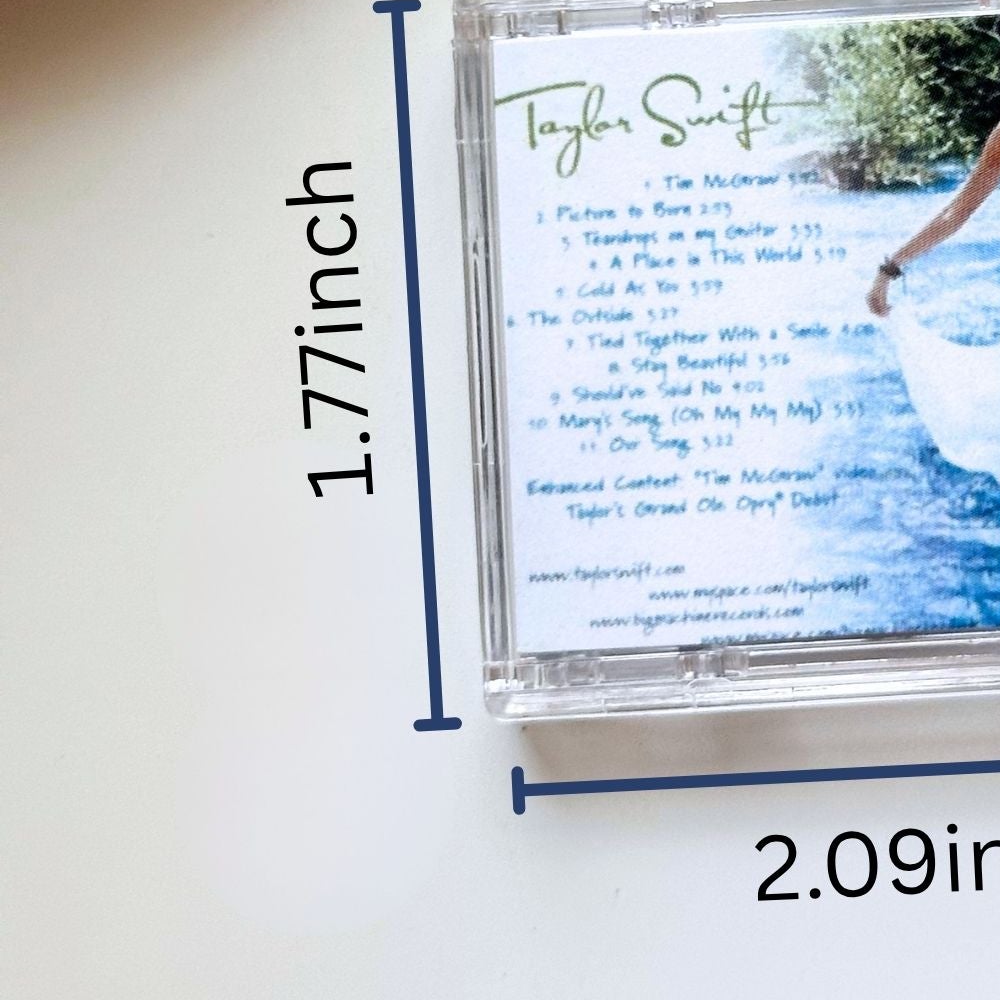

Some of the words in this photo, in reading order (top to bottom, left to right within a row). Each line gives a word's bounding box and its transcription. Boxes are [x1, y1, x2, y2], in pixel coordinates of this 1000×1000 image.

[496, 80, 633, 179] Taylor
[642, 73, 828, 151] Swift
[557, 204, 616, 222] Picture
[610, 254, 622, 270] A
[631, 357, 668, 384] Stay
[702, 380, 722, 396] No
[715, 404, 741, 428] My
[750, 402, 777, 426] My
[736, 490, 783, 517] Opry
